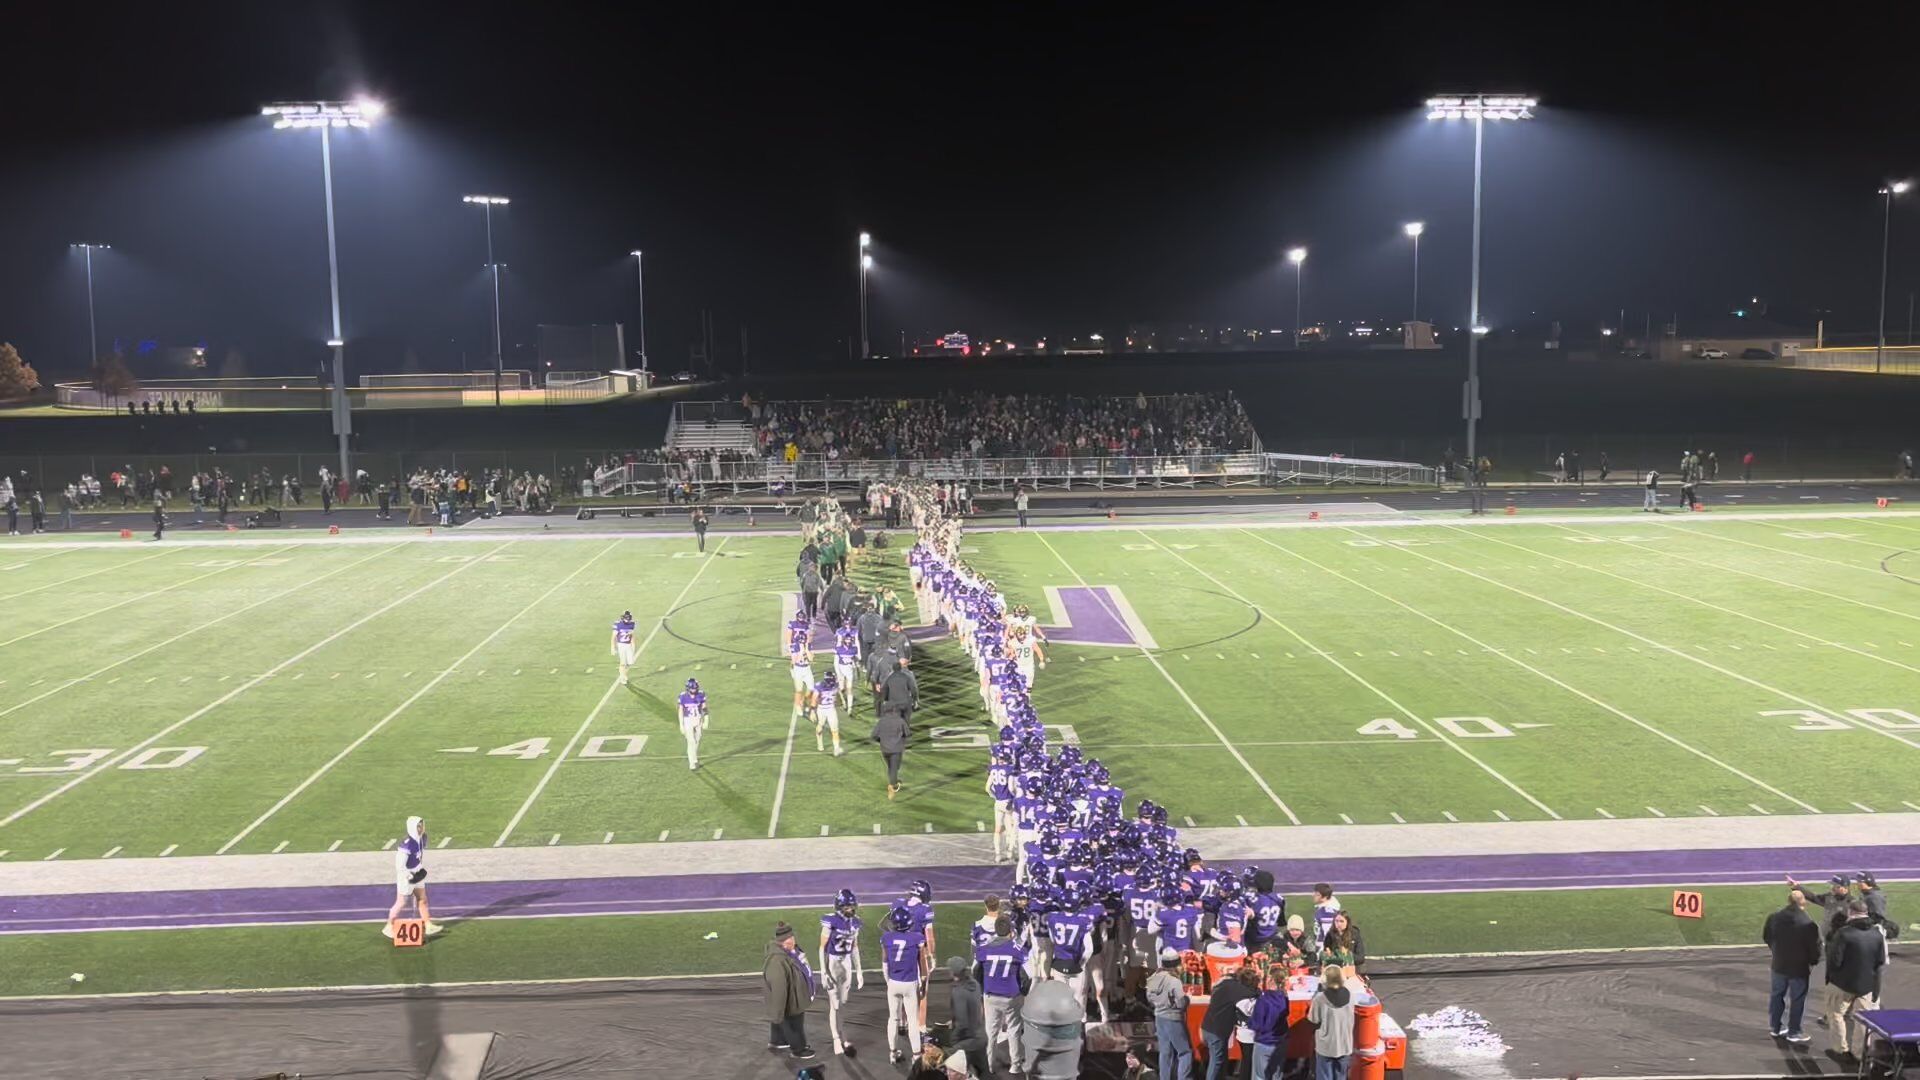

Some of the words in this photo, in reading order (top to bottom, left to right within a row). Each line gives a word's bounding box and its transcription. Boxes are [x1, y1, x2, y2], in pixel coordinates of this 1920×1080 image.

[1356, 718, 1517, 738] 40
[486, 735, 649, 759] 40
[17, 747, 209, 773] 30
[1130, 898, 1154, 920] 58
[1675, 893, 1699, 914] 40
[1258, 906, 1281, 927] 33
[397, 923, 420, 942] 40
[1054, 922, 1080, 945] 37
[1176, 919, 1188, 938] 6
[893, 939, 907, 961] 7
[986, 955, 1013, 977] 77
